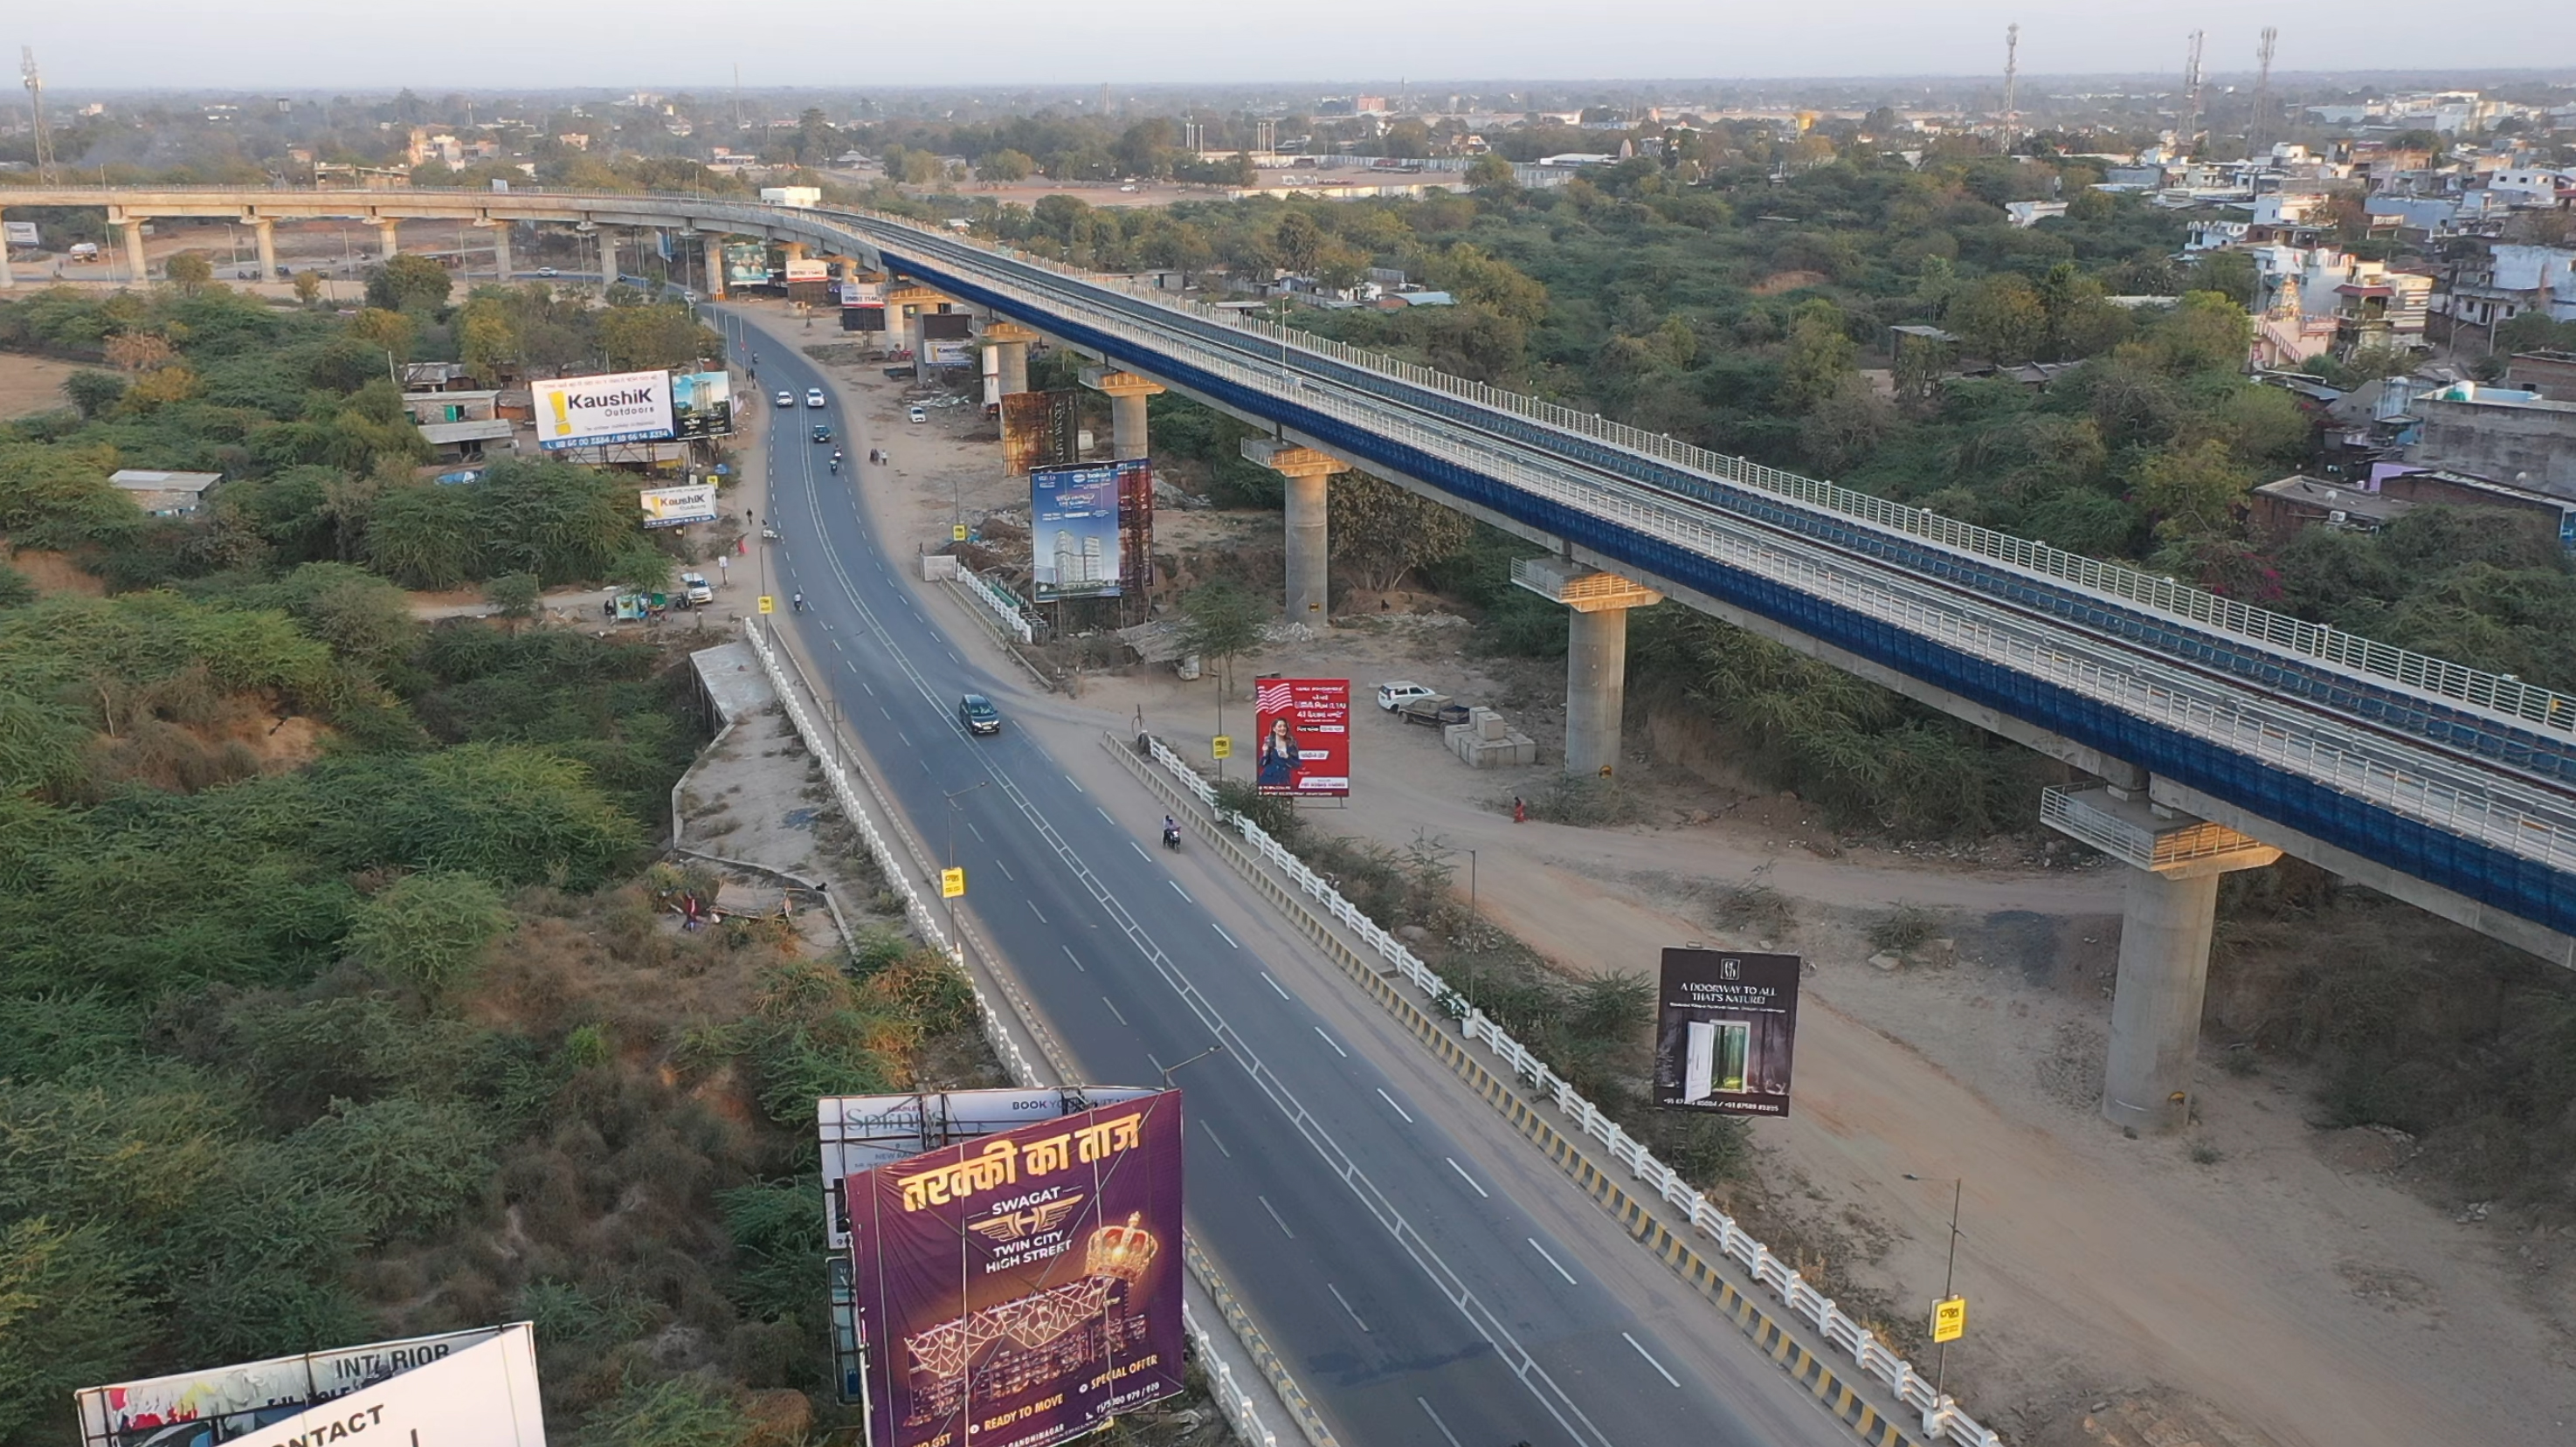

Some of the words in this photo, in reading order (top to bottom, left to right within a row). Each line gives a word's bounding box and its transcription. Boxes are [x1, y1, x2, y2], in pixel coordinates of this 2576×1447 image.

[568, 388, 653, 410] KaushiK
[604, 406, 654, 417] Outdoors
[1681, 982, 1688, 991] A
[1690, 982, 1741, 994] DOORWAY
[1744, 986, 1757, 995] TO
[1759, 987, 1777, 996] ALL
[1012, 1100, 1047, 1110] BOOK
[898, 1139, 1018, 1212] तरक्की
[1021, 1133, 1071, 1176] का
[1074, 1113, 1141, 1164] ताज
[991, 1186, 1060, 1215] SWAGAT
[985, 1256, 1020, 1274] HIGH
[1023, 1239, 1073, 1264] STREET
[992, 1238, 1030, 1258] TWIN
[1033, 1230, 1063, 1245] CITY
[335, 1343, 449, 1379] INTRIOR
[1091, 1366, 1127, 1389] SPECIAL
[1129, 1354, 1157, 1374] OFFER
[984, 1411, 1017, 1431] READY
[1019, 1406, 1032, 1418] TO
[1034, 1393, 1063, 1413] MOVE
